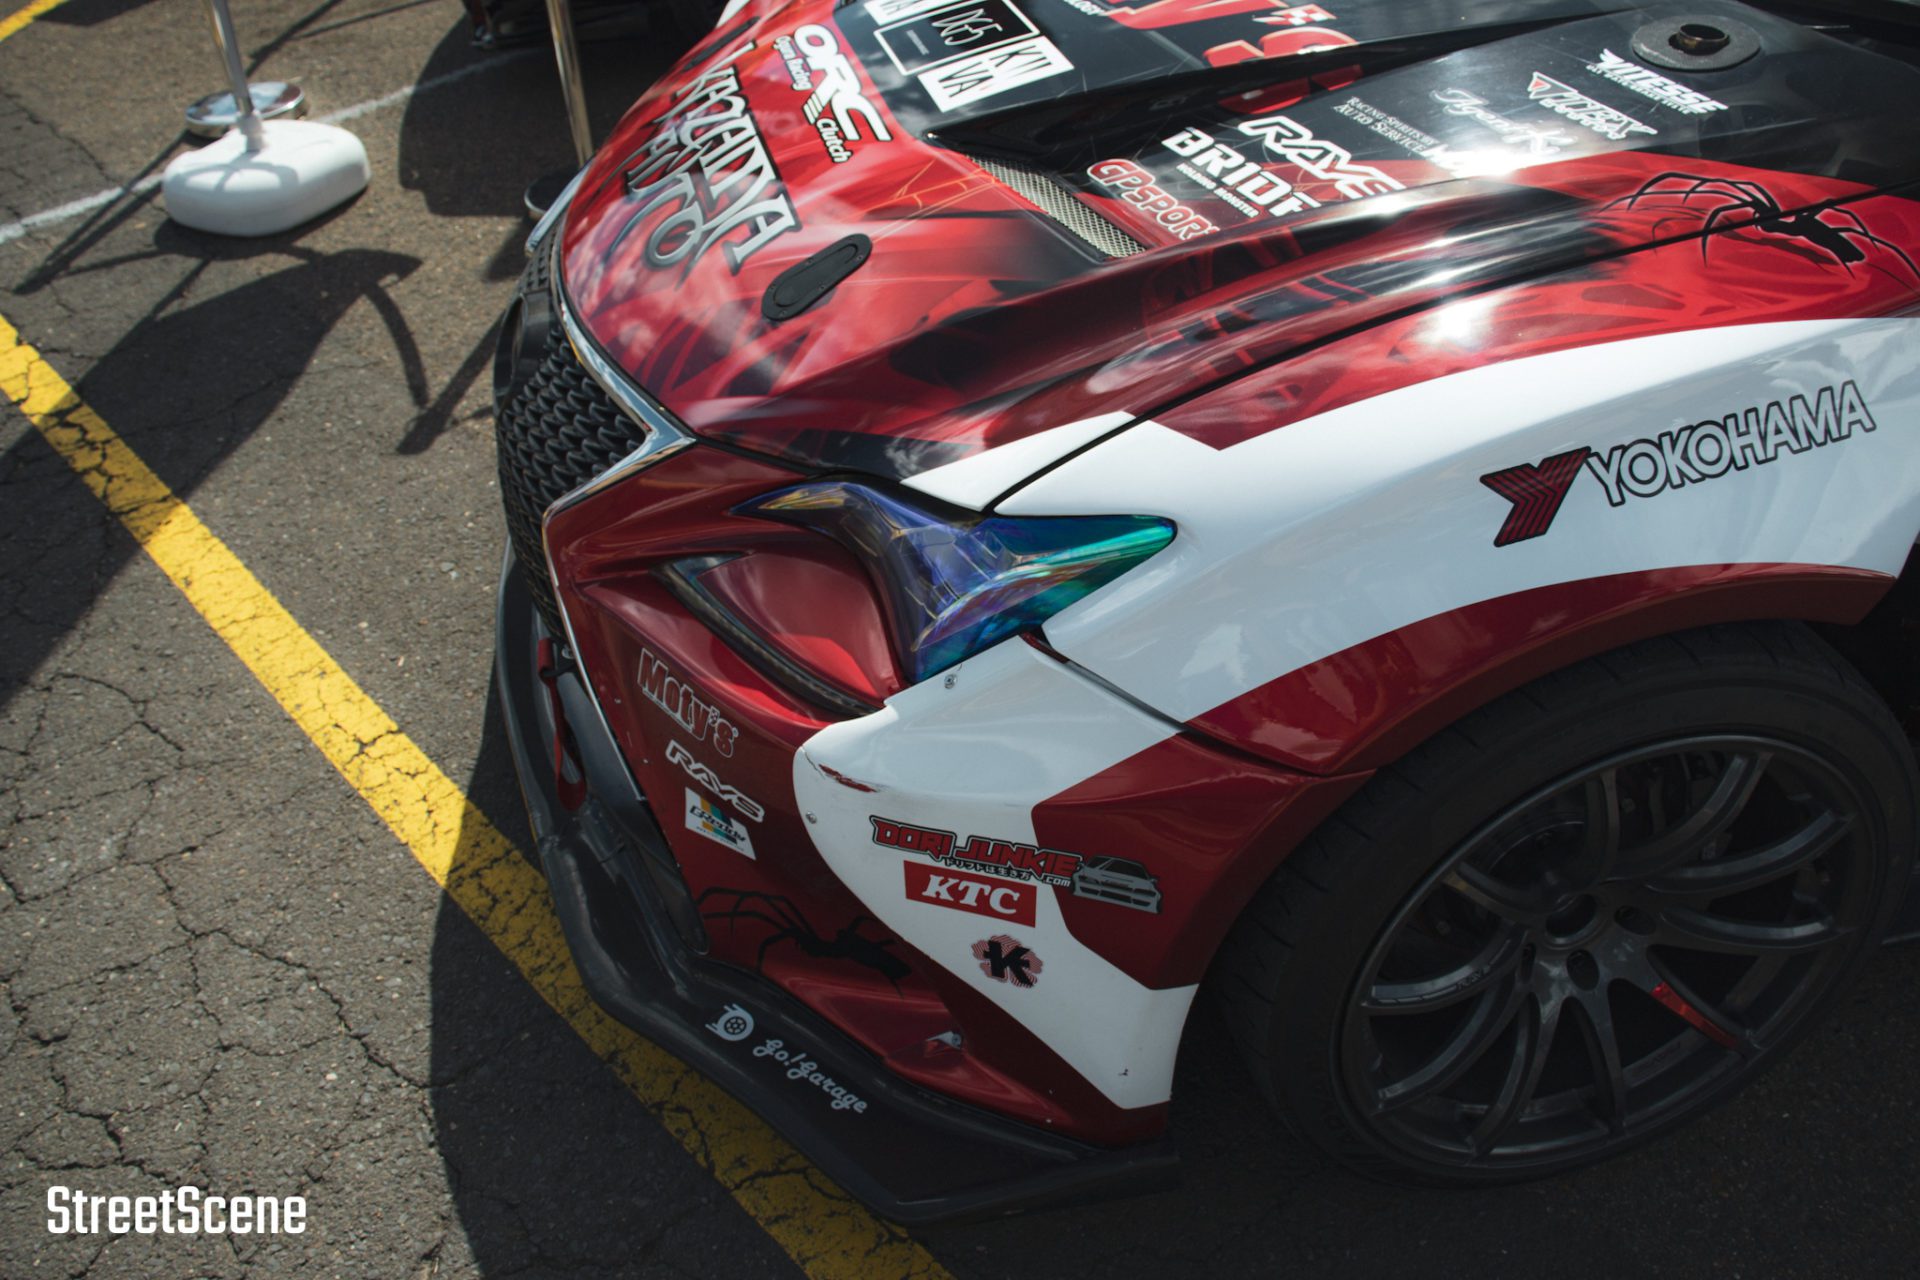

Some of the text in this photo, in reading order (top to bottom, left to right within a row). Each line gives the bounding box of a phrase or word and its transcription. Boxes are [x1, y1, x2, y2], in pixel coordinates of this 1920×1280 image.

[785, 57, 814, 91] Racing
[794, 24, 892, 141] ORC
[1599, 48, 1729, 114] VITESSE
[816, 117, 854, 163] Clutch
[1238, 115, 1407, 200] RAYS
[1333, 103, 1428, 154] AUTO SERVICE
[1213, 187, 1260, 218] MONSTER
[1584, 379, 1877, 507] YOKOHAMA
[665, 739, 766, 823] RAYS
[869, 815, 1083, 880] DORI JUNKIE
[921, 873, 1021, 915] KTC
